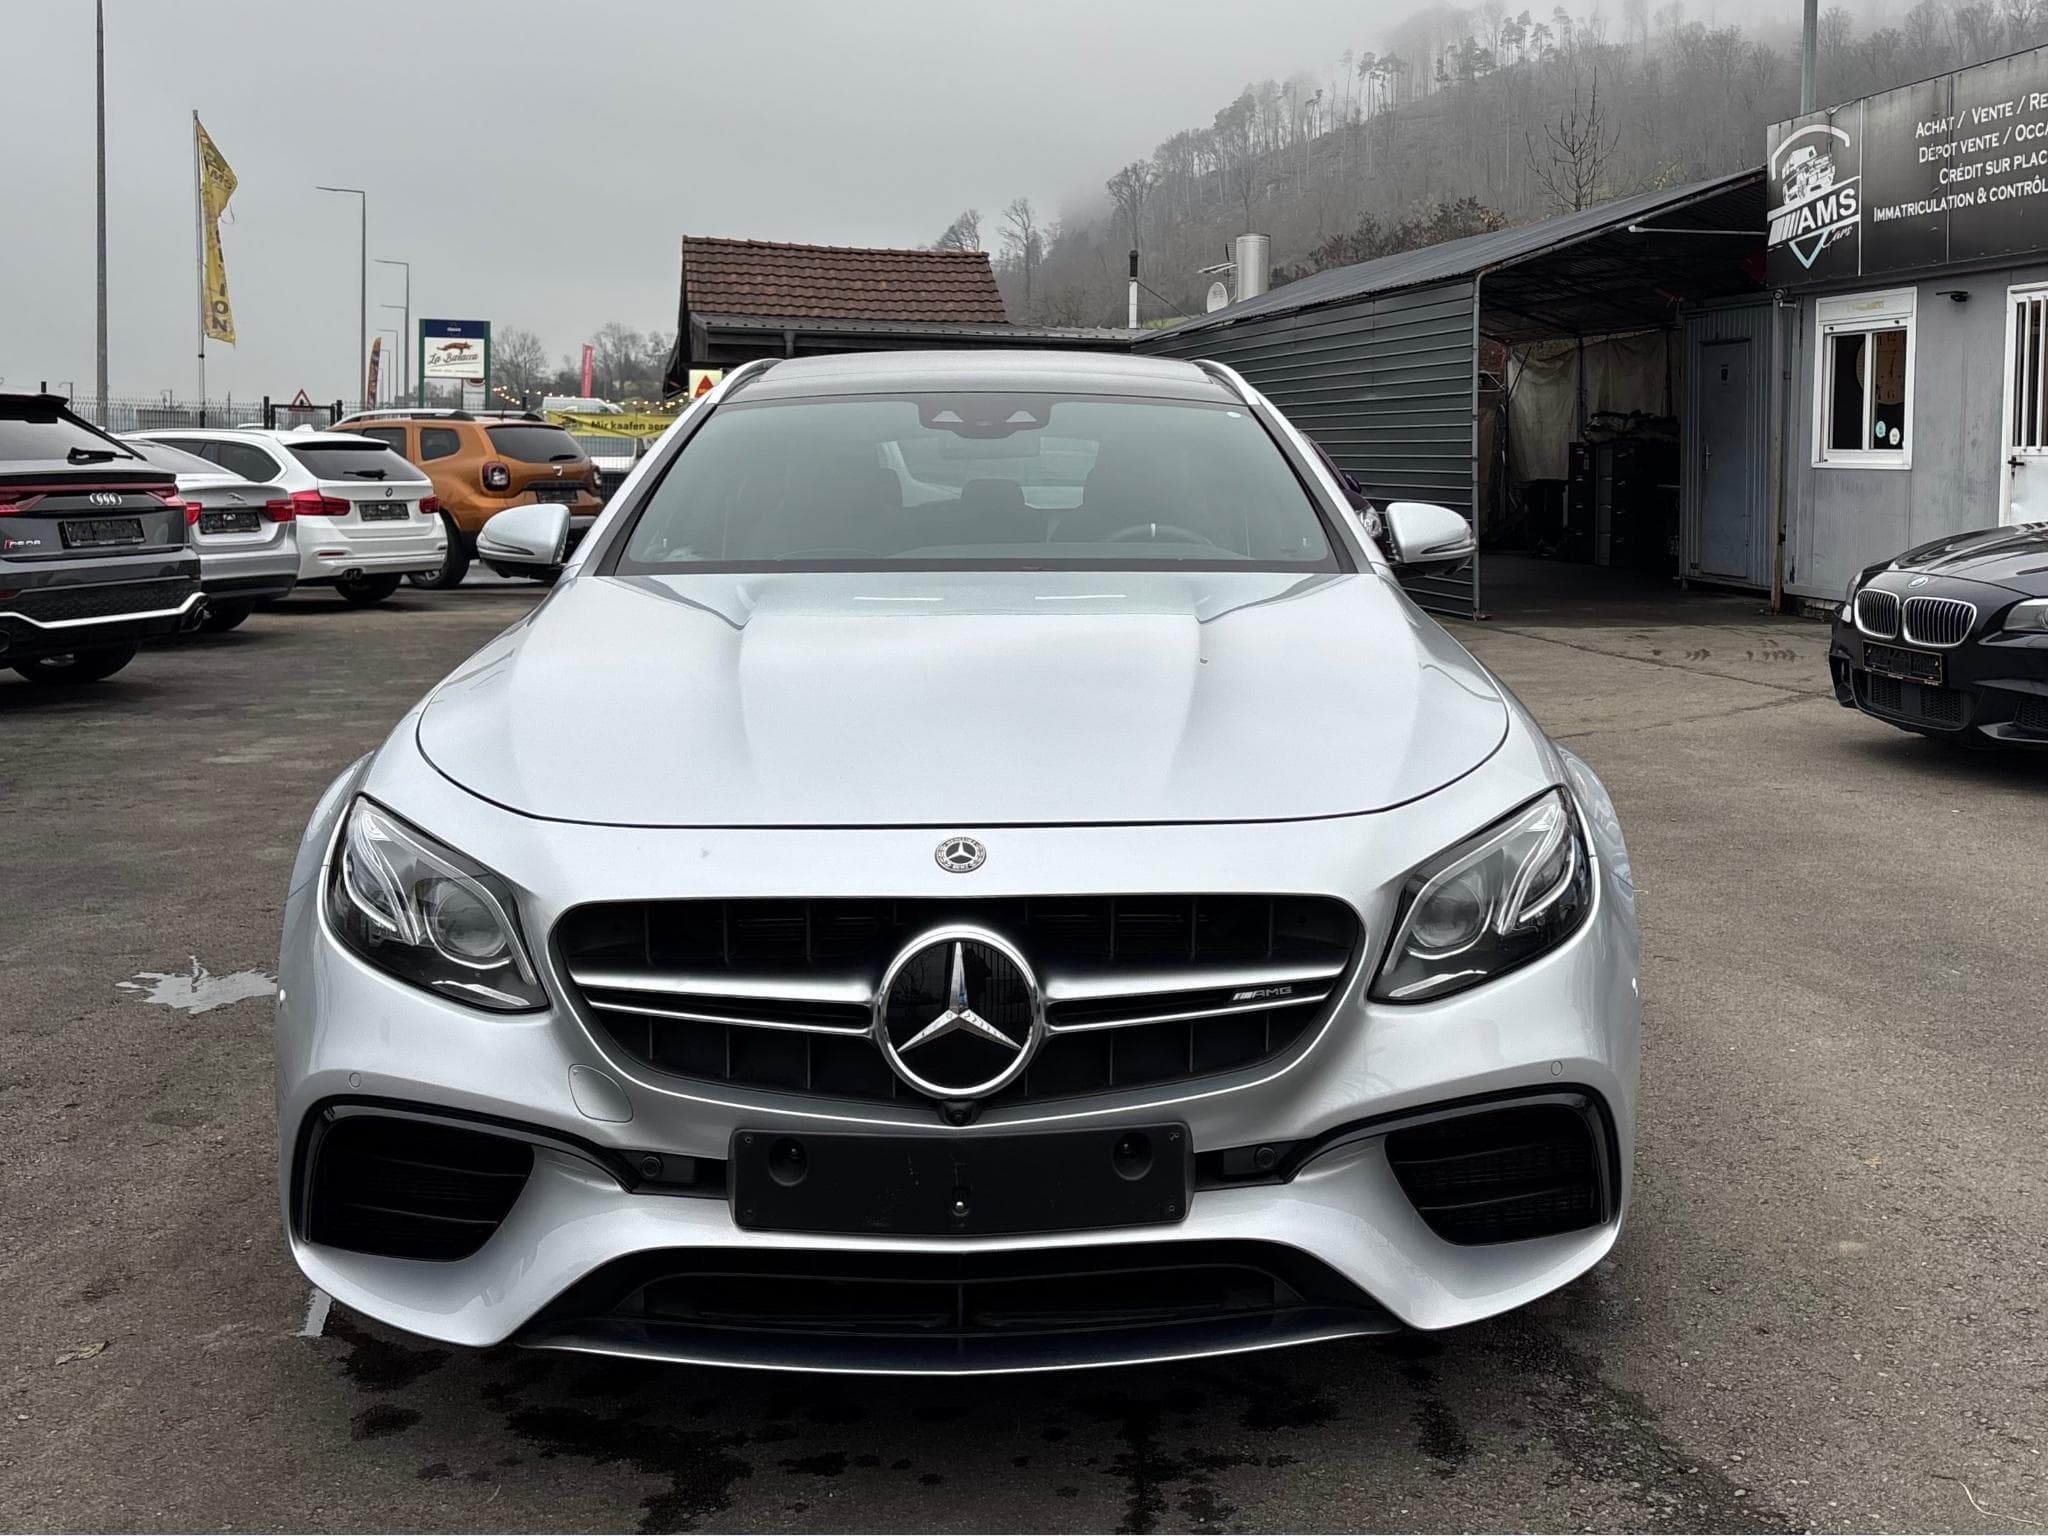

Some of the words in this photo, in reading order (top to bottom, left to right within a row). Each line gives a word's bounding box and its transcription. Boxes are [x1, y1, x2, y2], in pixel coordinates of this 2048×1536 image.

[1985, 157, 2011, 176] SUR
[1976, 187, 1987, 205] &
[611, 420, 646, 432] kaafen
[1252, 986, 1292, 999] AMG
